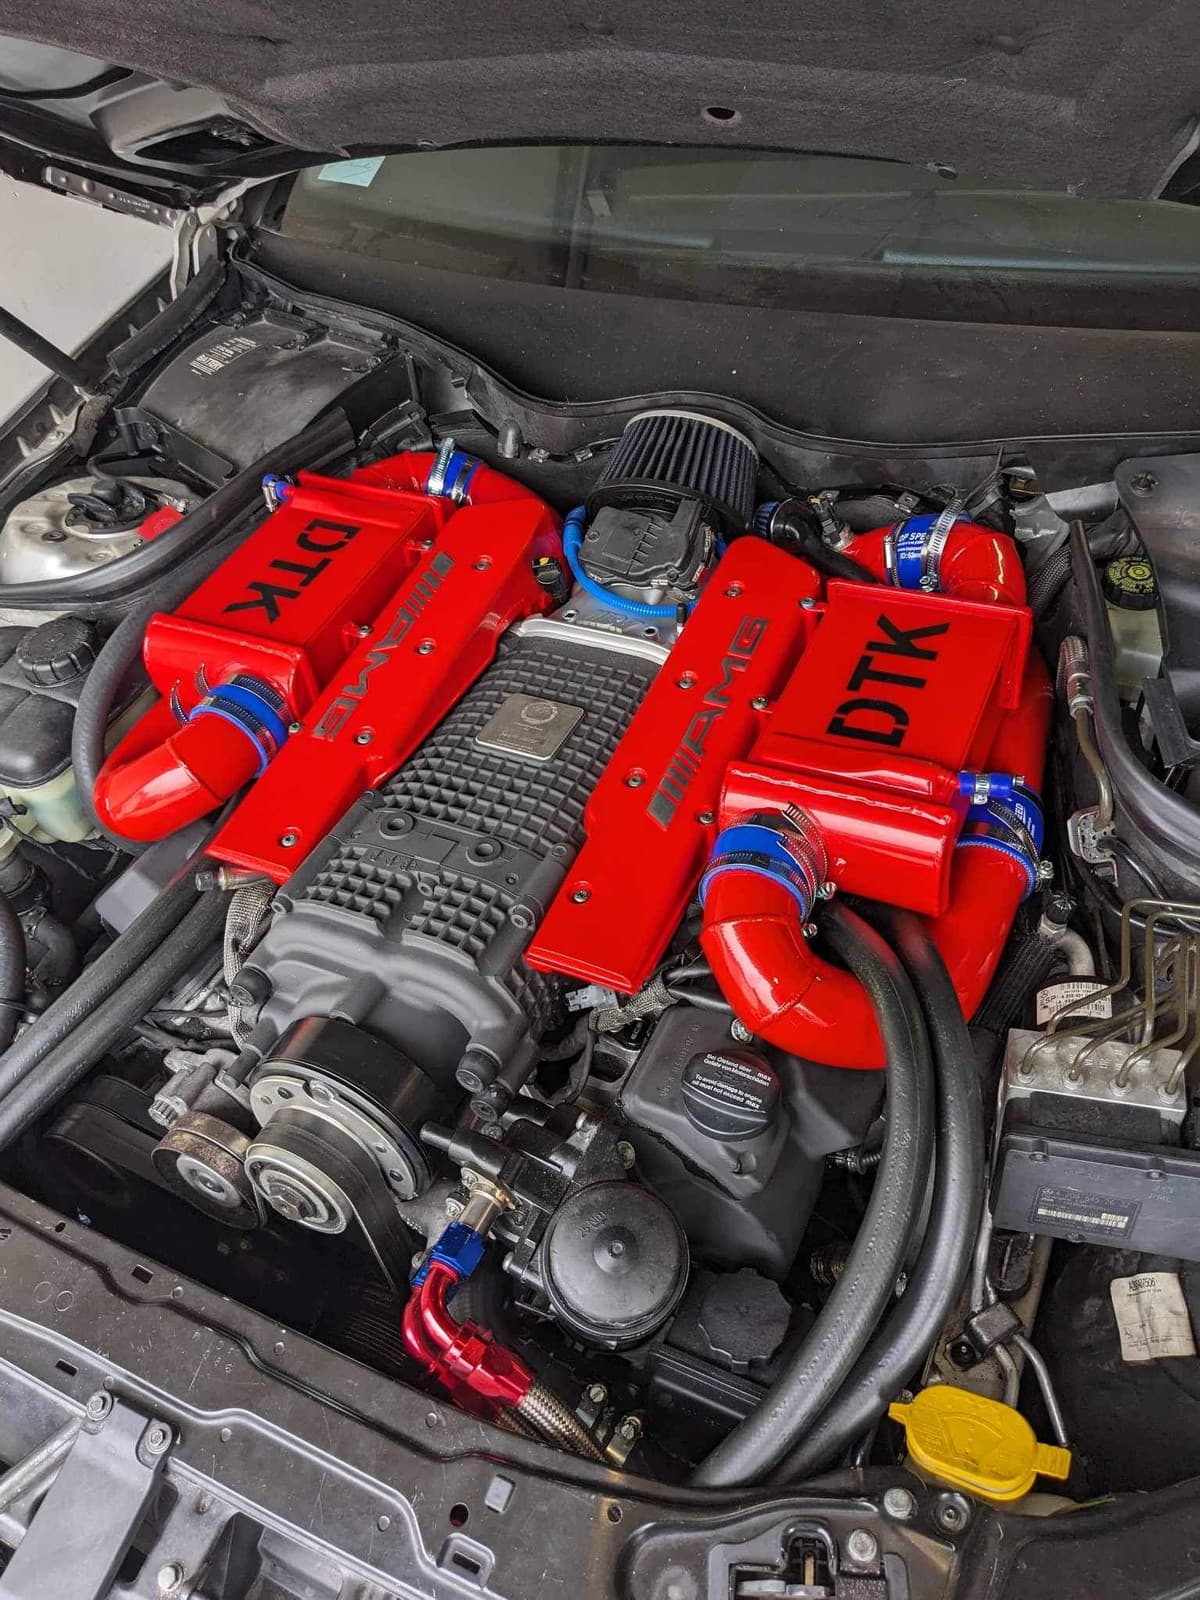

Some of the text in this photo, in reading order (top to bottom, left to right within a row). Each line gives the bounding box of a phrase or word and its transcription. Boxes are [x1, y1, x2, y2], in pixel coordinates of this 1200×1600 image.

[222, 518, 362, 624] DTK
[312, 606, 416, 741] AMG
[682, 616, 769, 756] AMG
[825, 613, 951, 748] DTK
[699, 1081, 714, 1091] must
[713, 1086, 723, 1094] not
[723, 1089, 745, 1103] exceed
[745, 1098, 760, 1109] max
[702, 1077, 717, 1086] avoid
[716, 1081, 738, 1094] damage
[744, 1092, 762, 1104] engine
[721, 1064, 732, 1072] von
[756, 1072, 772, 1082] max
